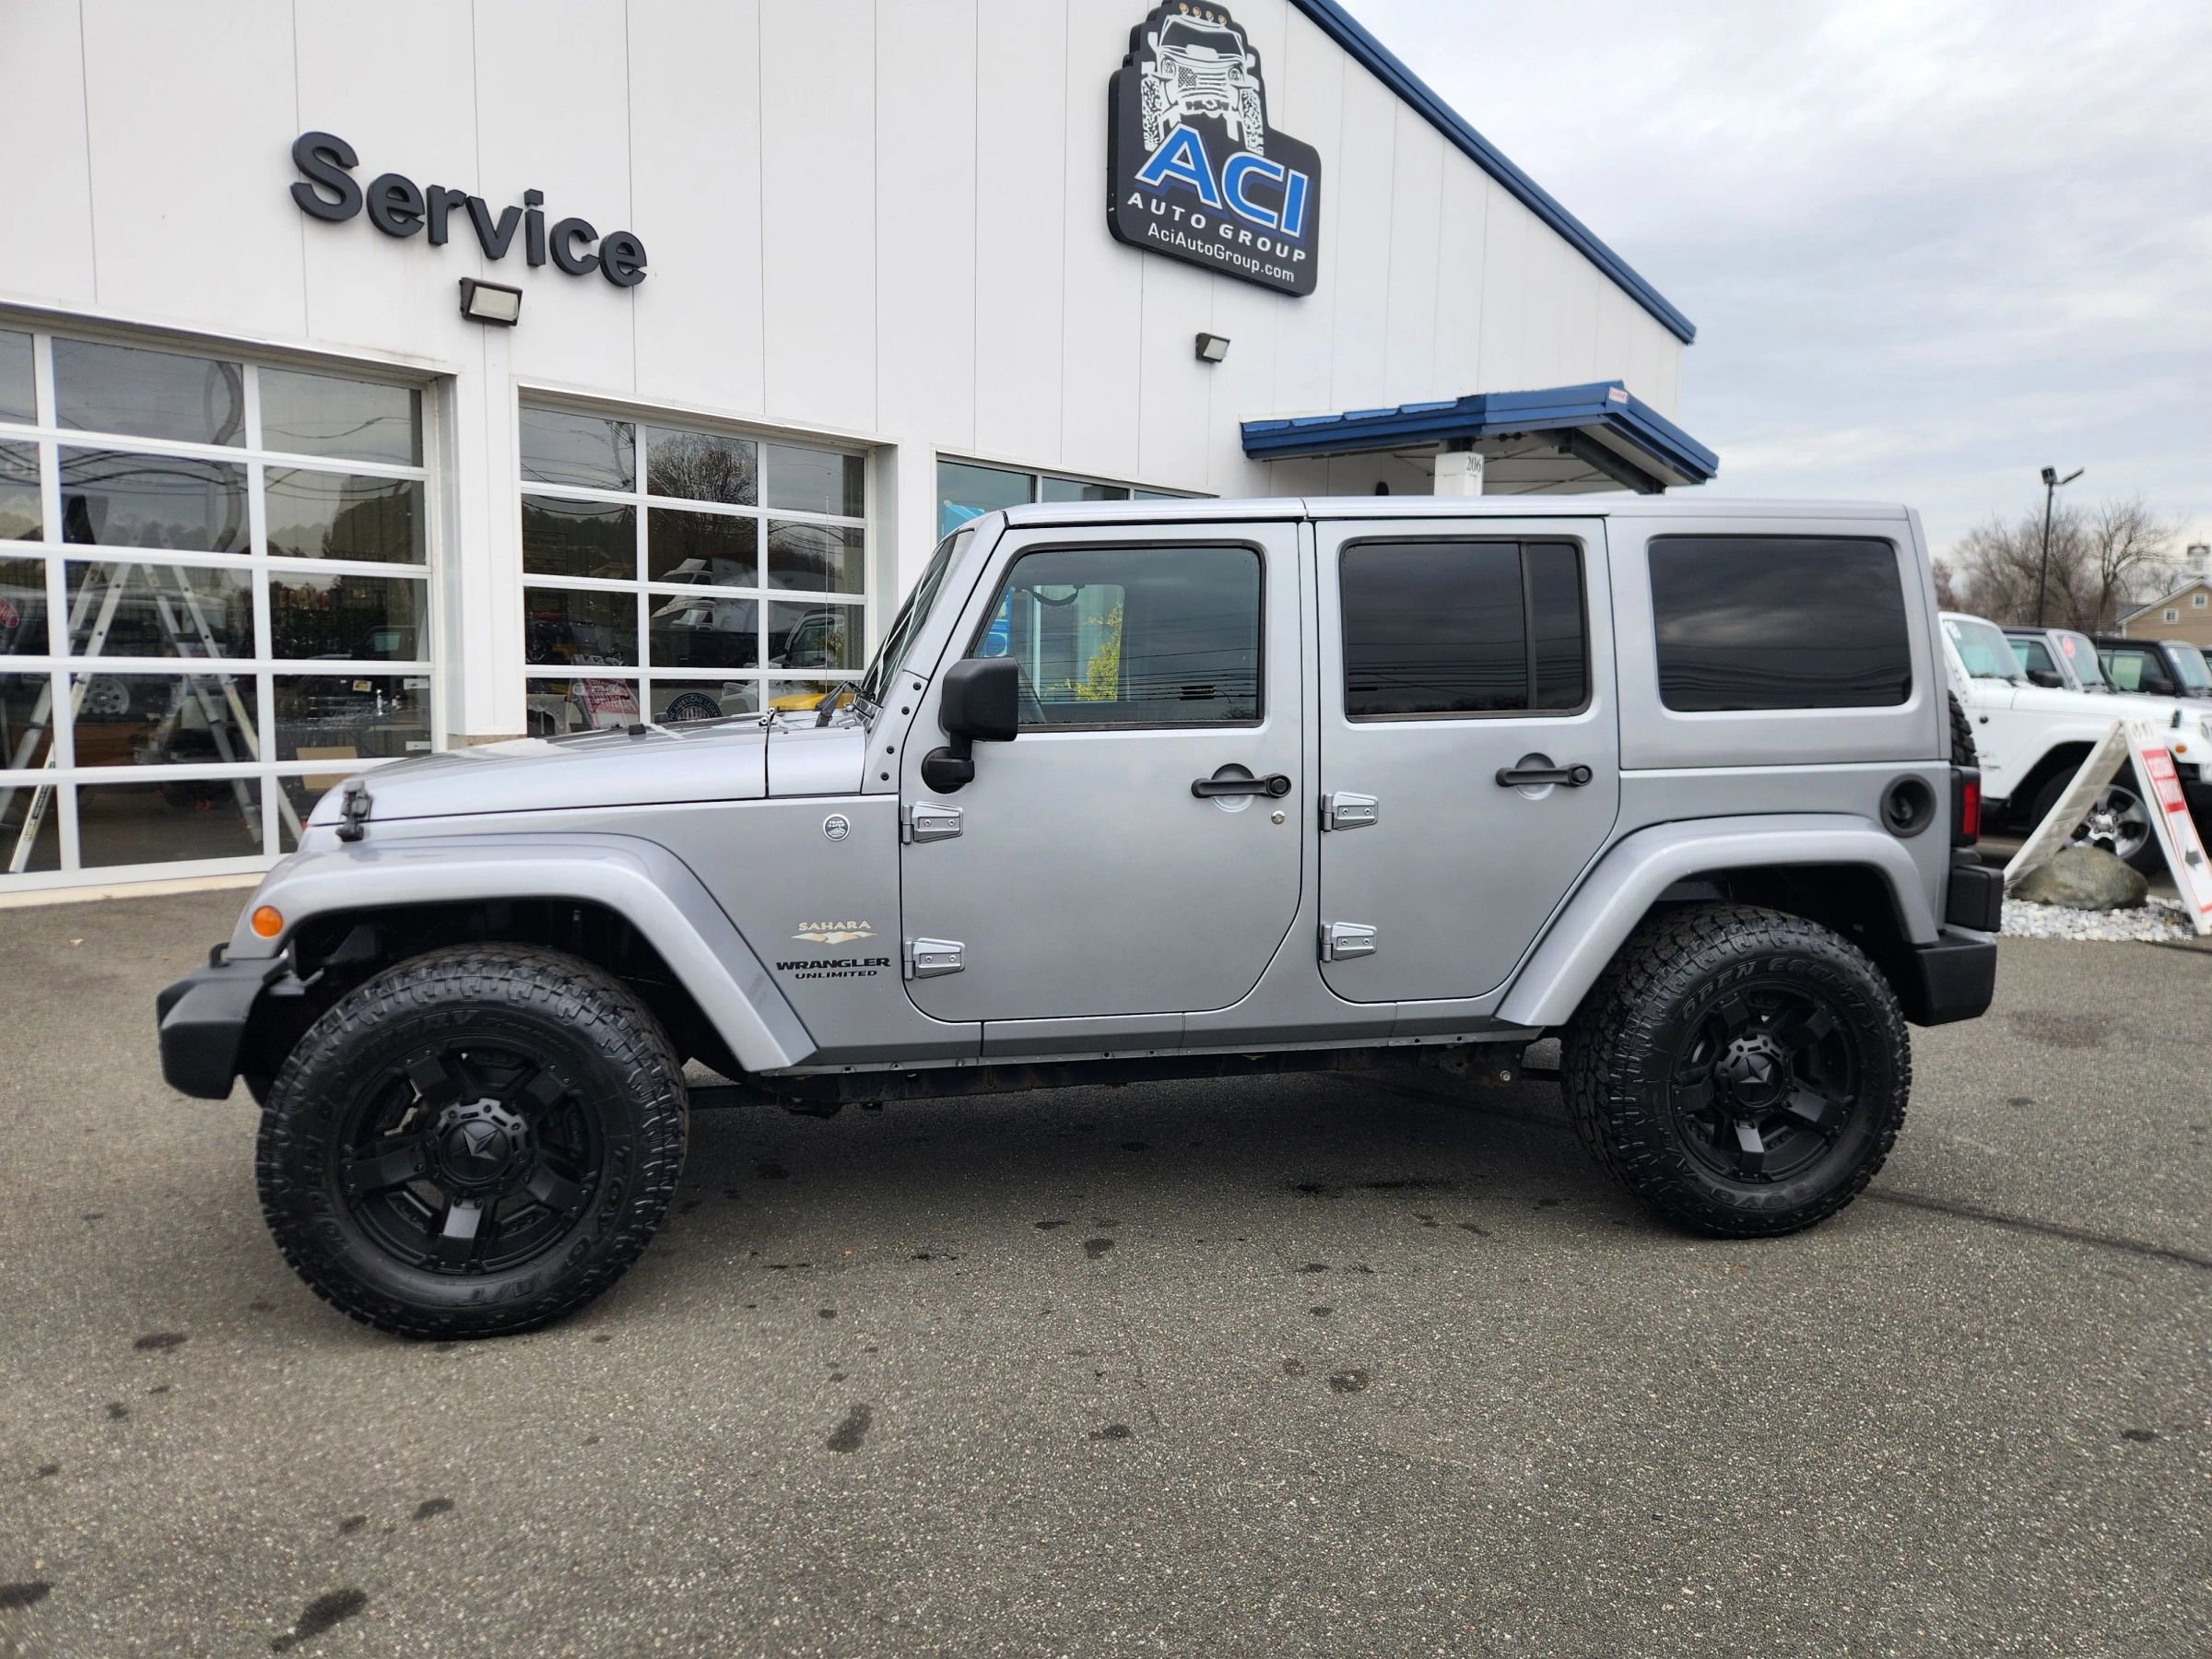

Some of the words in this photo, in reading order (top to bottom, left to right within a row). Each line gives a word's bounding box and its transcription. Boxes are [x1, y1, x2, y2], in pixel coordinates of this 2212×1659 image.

[288, 131, 649, 288] Service
[1134, 122, 1310, 239] ACI
[1127, 192, 1206, 229] AUTO
[1218, 223, 1307, 263] GROUP
[1147, 222, 1295, 283] AciAutoGroup.com
[1466, 456, 1481, 473] 206
[798, 921, 871, 931] SAHARA
[776, 958, 891, 971] WRANGLER
[794, 971, 877, 979] UNLIMITED
[1681, 960, 1757, 1021] OPEN
